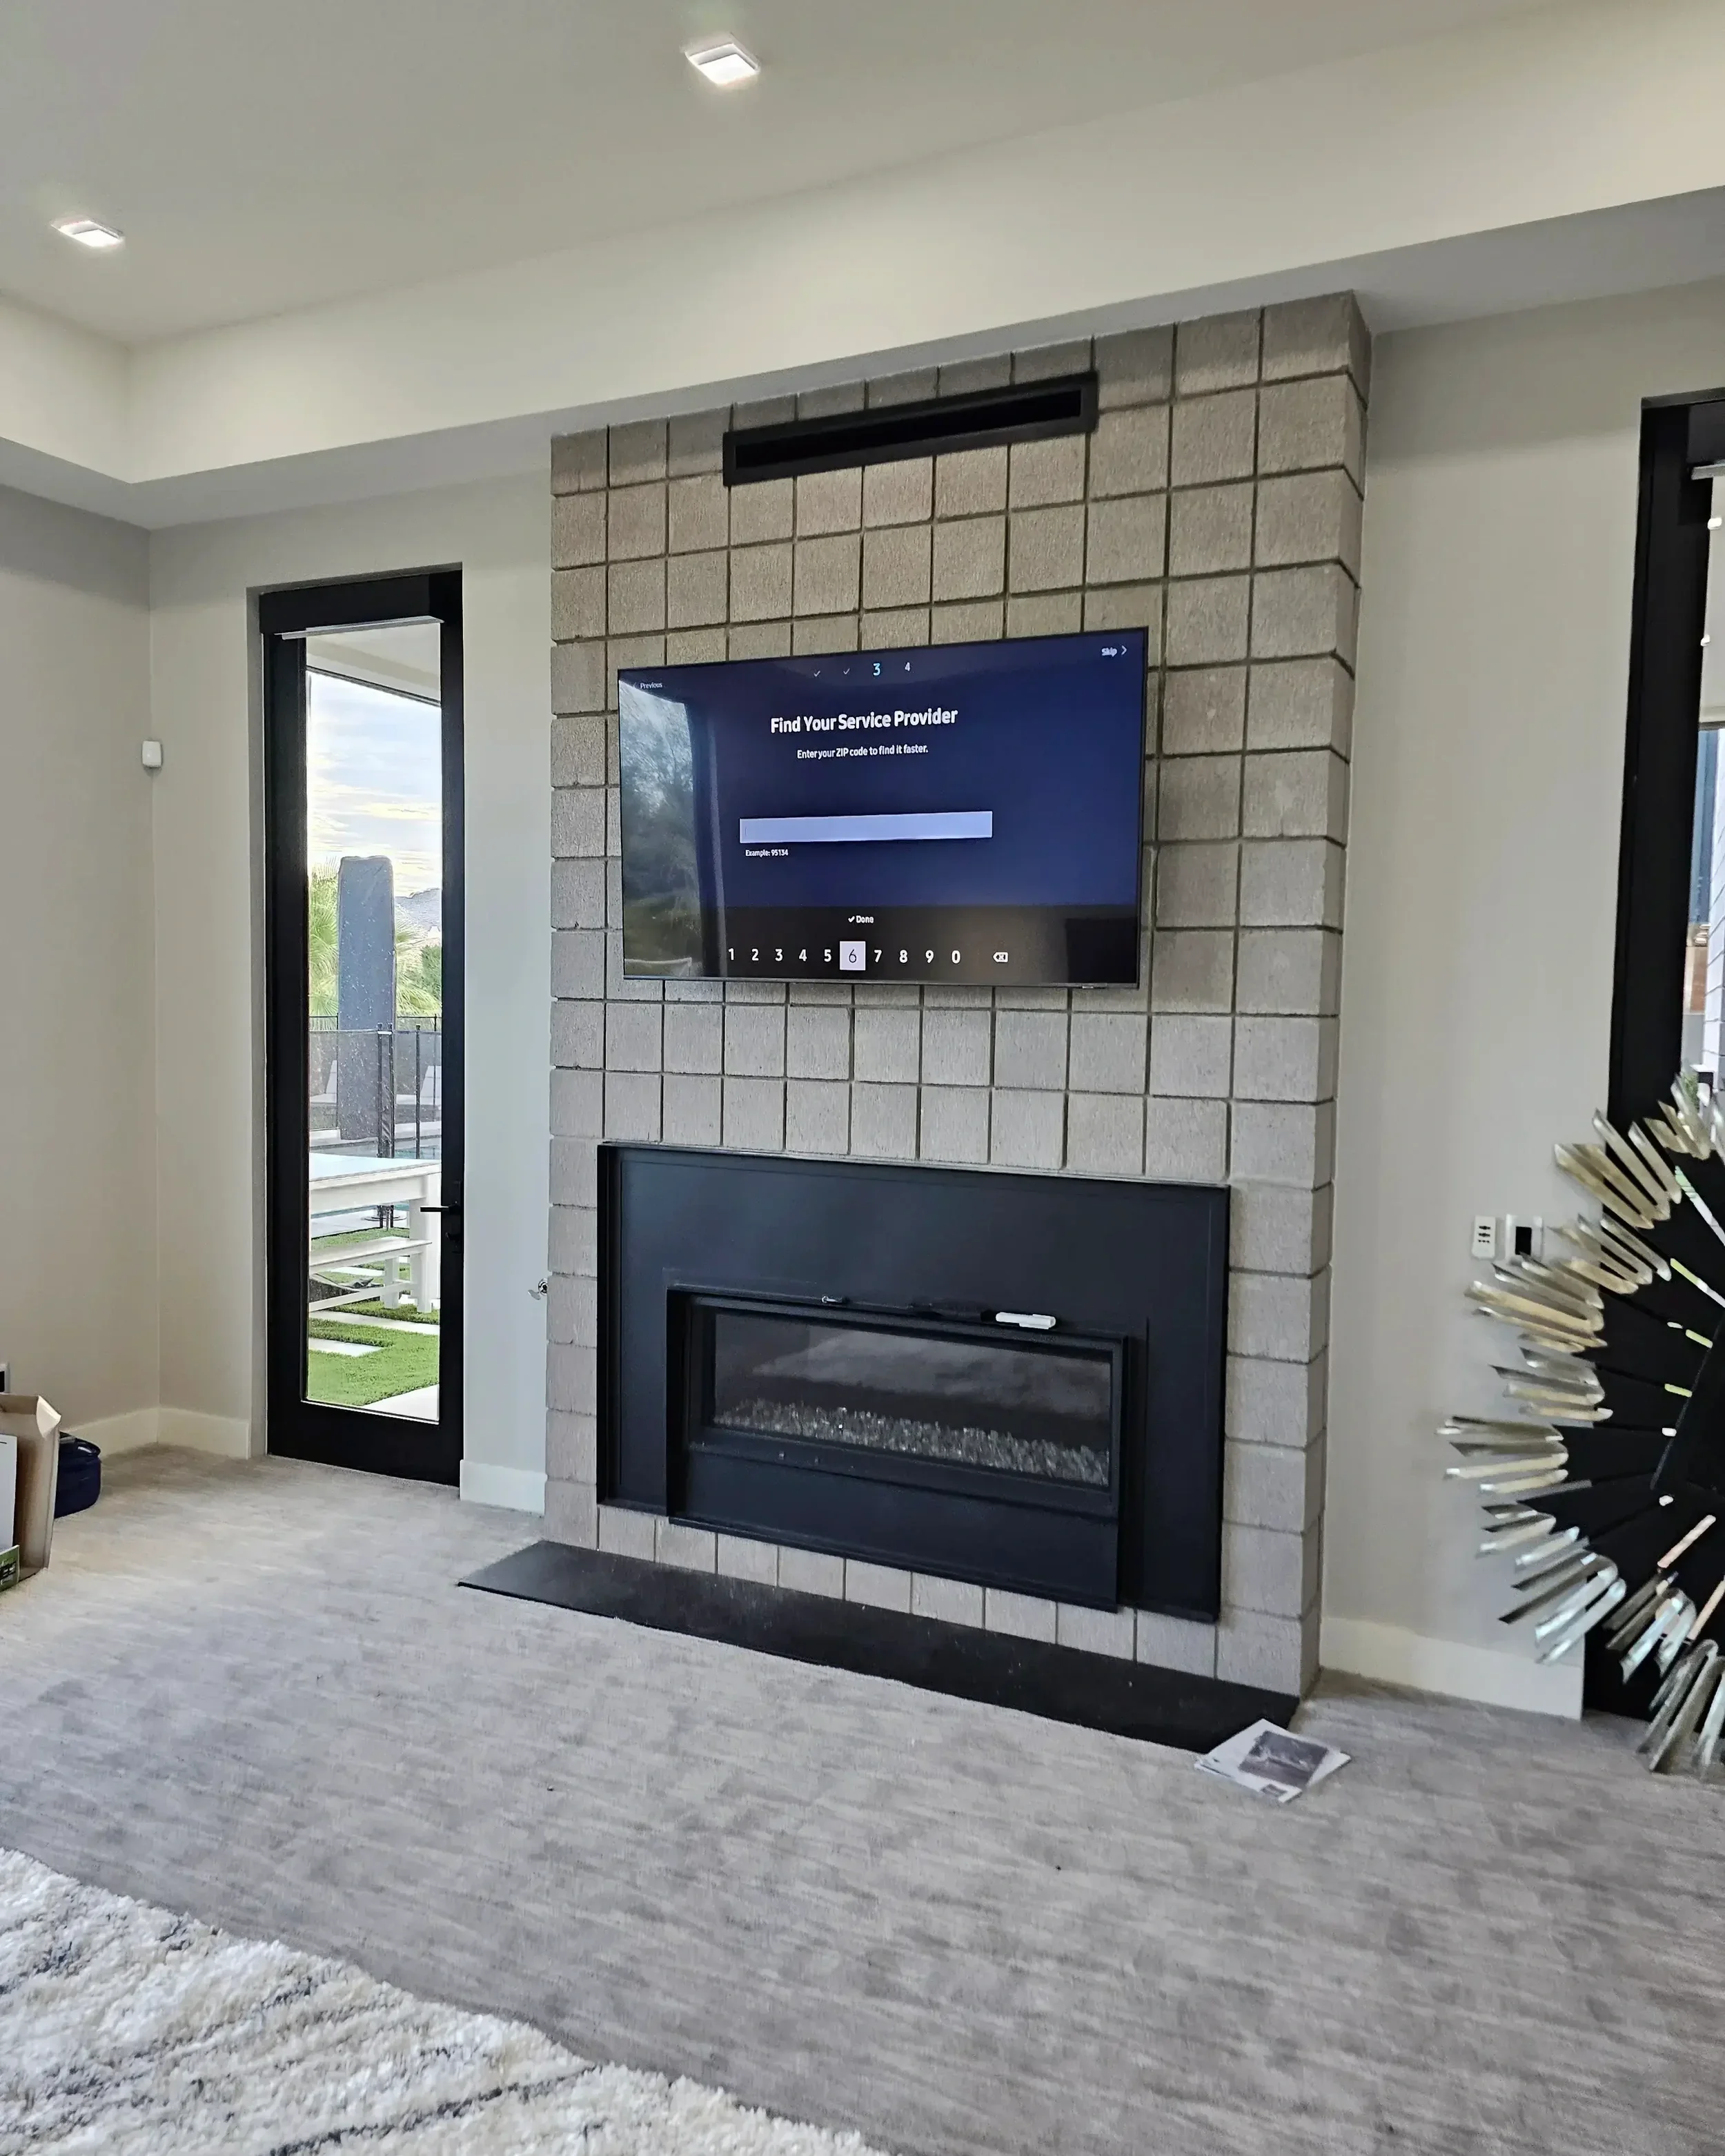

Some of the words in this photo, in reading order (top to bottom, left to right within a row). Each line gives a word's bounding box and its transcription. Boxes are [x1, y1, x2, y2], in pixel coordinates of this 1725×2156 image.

[873, 663, 880, 676] 3
[904, 662, 911, 672] 4
[771, 716, 801, 734] Find
[803, 715, 837, 732] Your
[838, 711, 891, 730] Service
[894, 707, 958, 727] Provider
[796, 749, 817, 759] Enter
[817, 748, 836, 760] your
[836, 746, 849, 758] ZIP
[849, 745, 868, 757] code
[869, 746, 878, 756] to
[878, 745, 895, 756] find
[896, 744, 903, 754] it
[903, 743, 929, 754] faster.
[745, 849, 771, 858] Example:
[856, 915, 874, 923] Done
[728, 948, 735, 961] 1
[751, 948, 759, 961] 2
[775, 948, 783, 961] 3
[798, 949, 807, 962] 4
[824, 949, 832, 962] 5
[848, 949, 858, 963] 6
[874, 949, 883, 963] 7
[899, 949, 908, 963] 8
[925, 950, 934, 964] 9
[951, 950, 961, 964] 0
